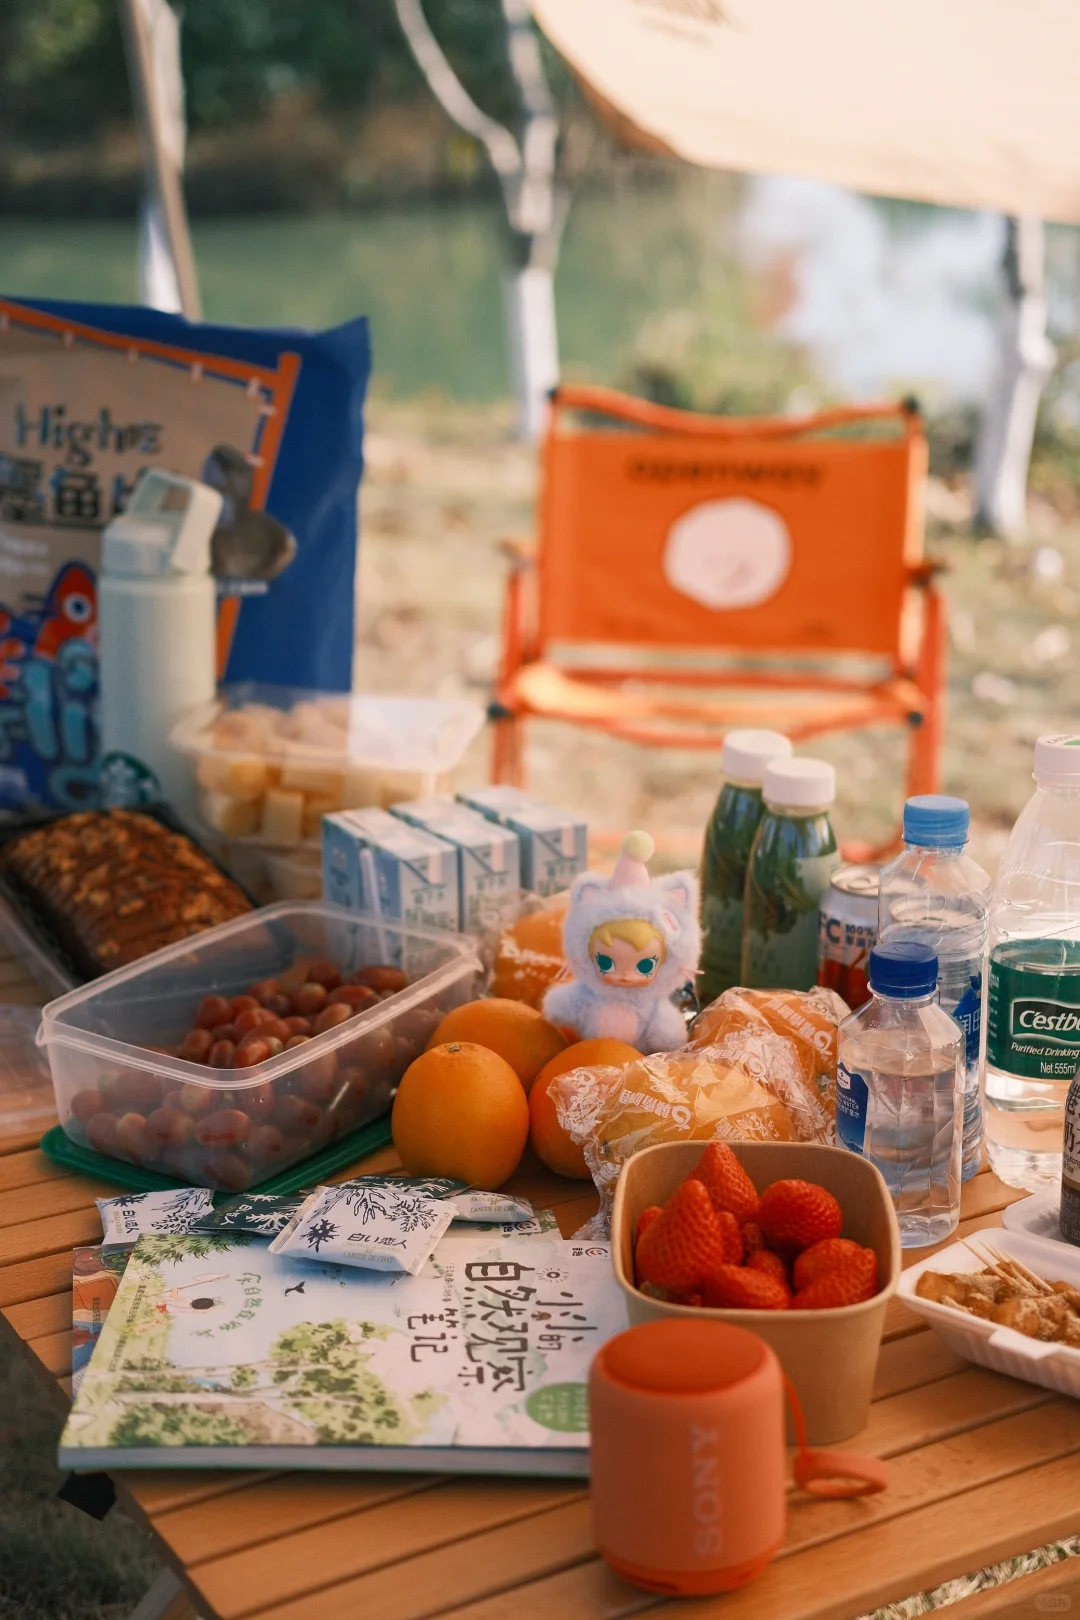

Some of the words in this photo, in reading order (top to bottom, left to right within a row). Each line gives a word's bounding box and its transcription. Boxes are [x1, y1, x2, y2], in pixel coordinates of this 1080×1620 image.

[1010, 1041, 1044, 1056] Purified
[1045, 1047, 1080, 1060] Drinking
[1040, 1061, 1054, 1074] Net
[1054, 1062, 1077, 1075] 555ml
[347, 1232, 408, 1250] 白い恋人
[407, 1308, 460, 1362] 笔记
[457, 1262, 537, 1392] 自然观察
[536, 1291, 598, 1350] 小小的
[690, 1420, 722, 1557] SONY
